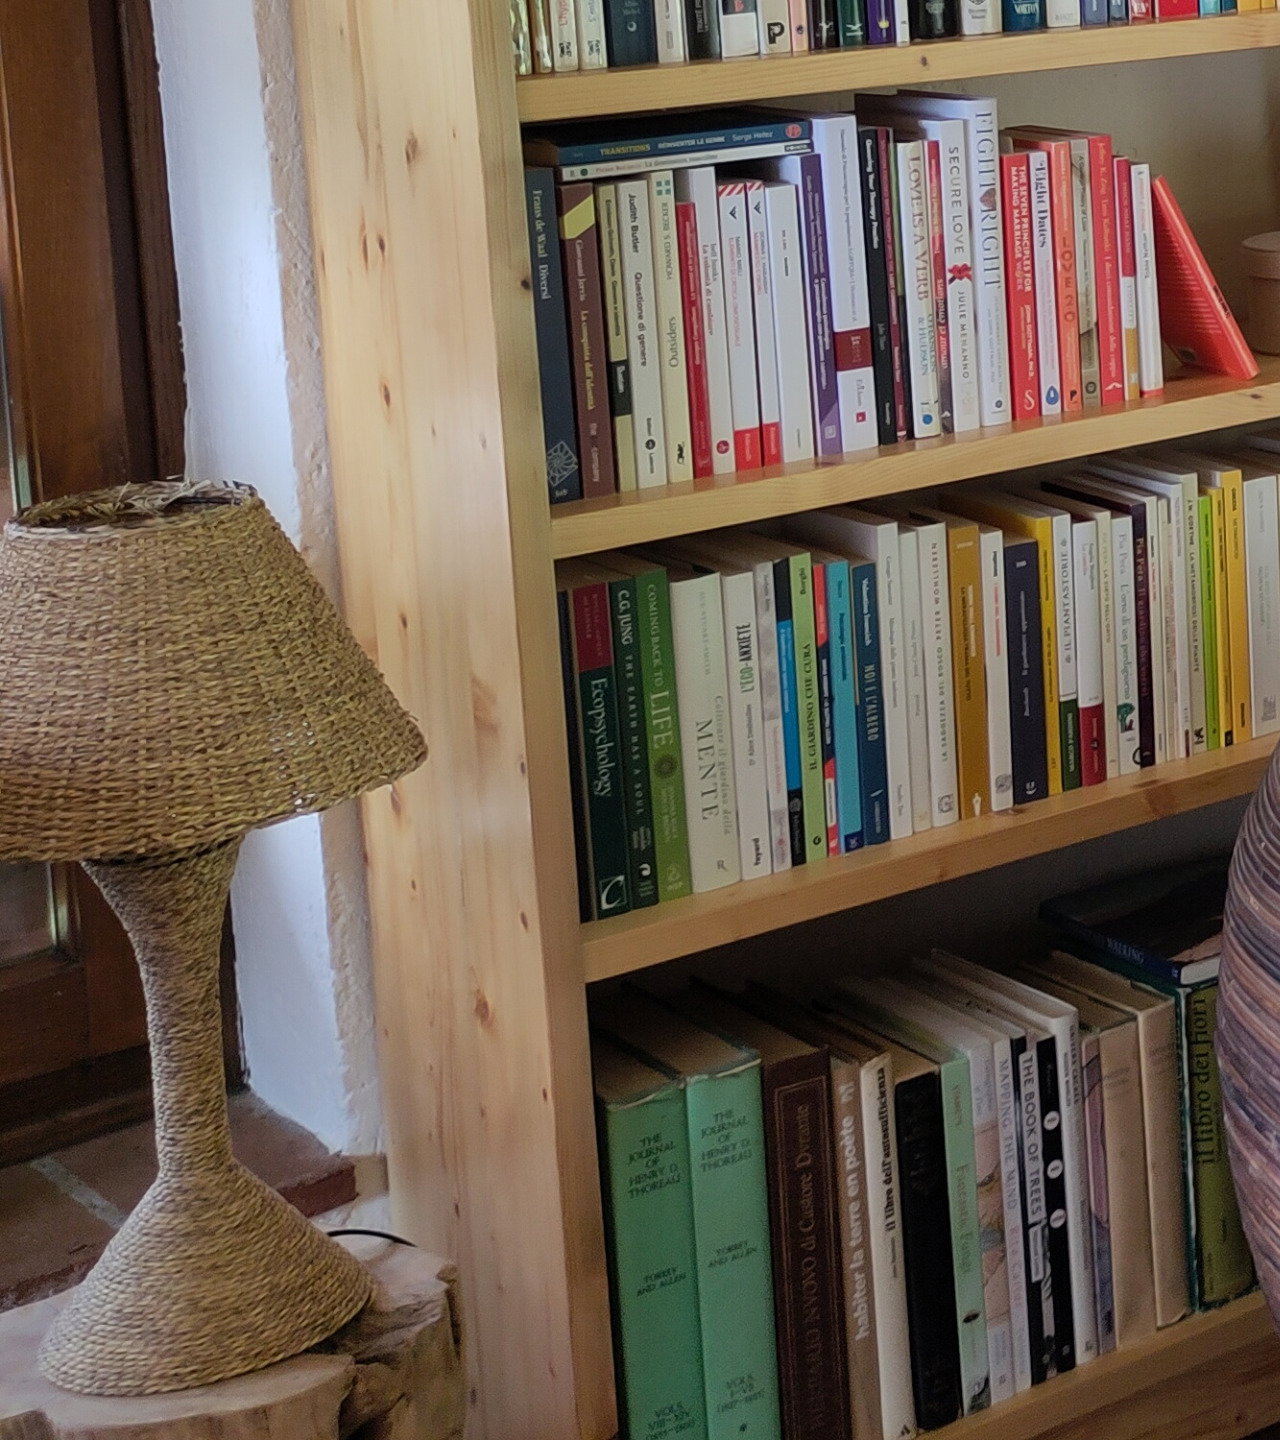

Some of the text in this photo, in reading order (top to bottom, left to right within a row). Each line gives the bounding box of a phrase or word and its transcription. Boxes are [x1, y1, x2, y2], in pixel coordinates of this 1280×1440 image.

[948, 145, 967, 255] SECURE LOVE
[975, 109, 1002, 291] FIGHT RIGHT
[586, 677, 616, 798] Ecopsychology
[695, 717, 720, 821] MENTE
[1023, 1055, 1043, 1216] THE BOOK OF TREES
